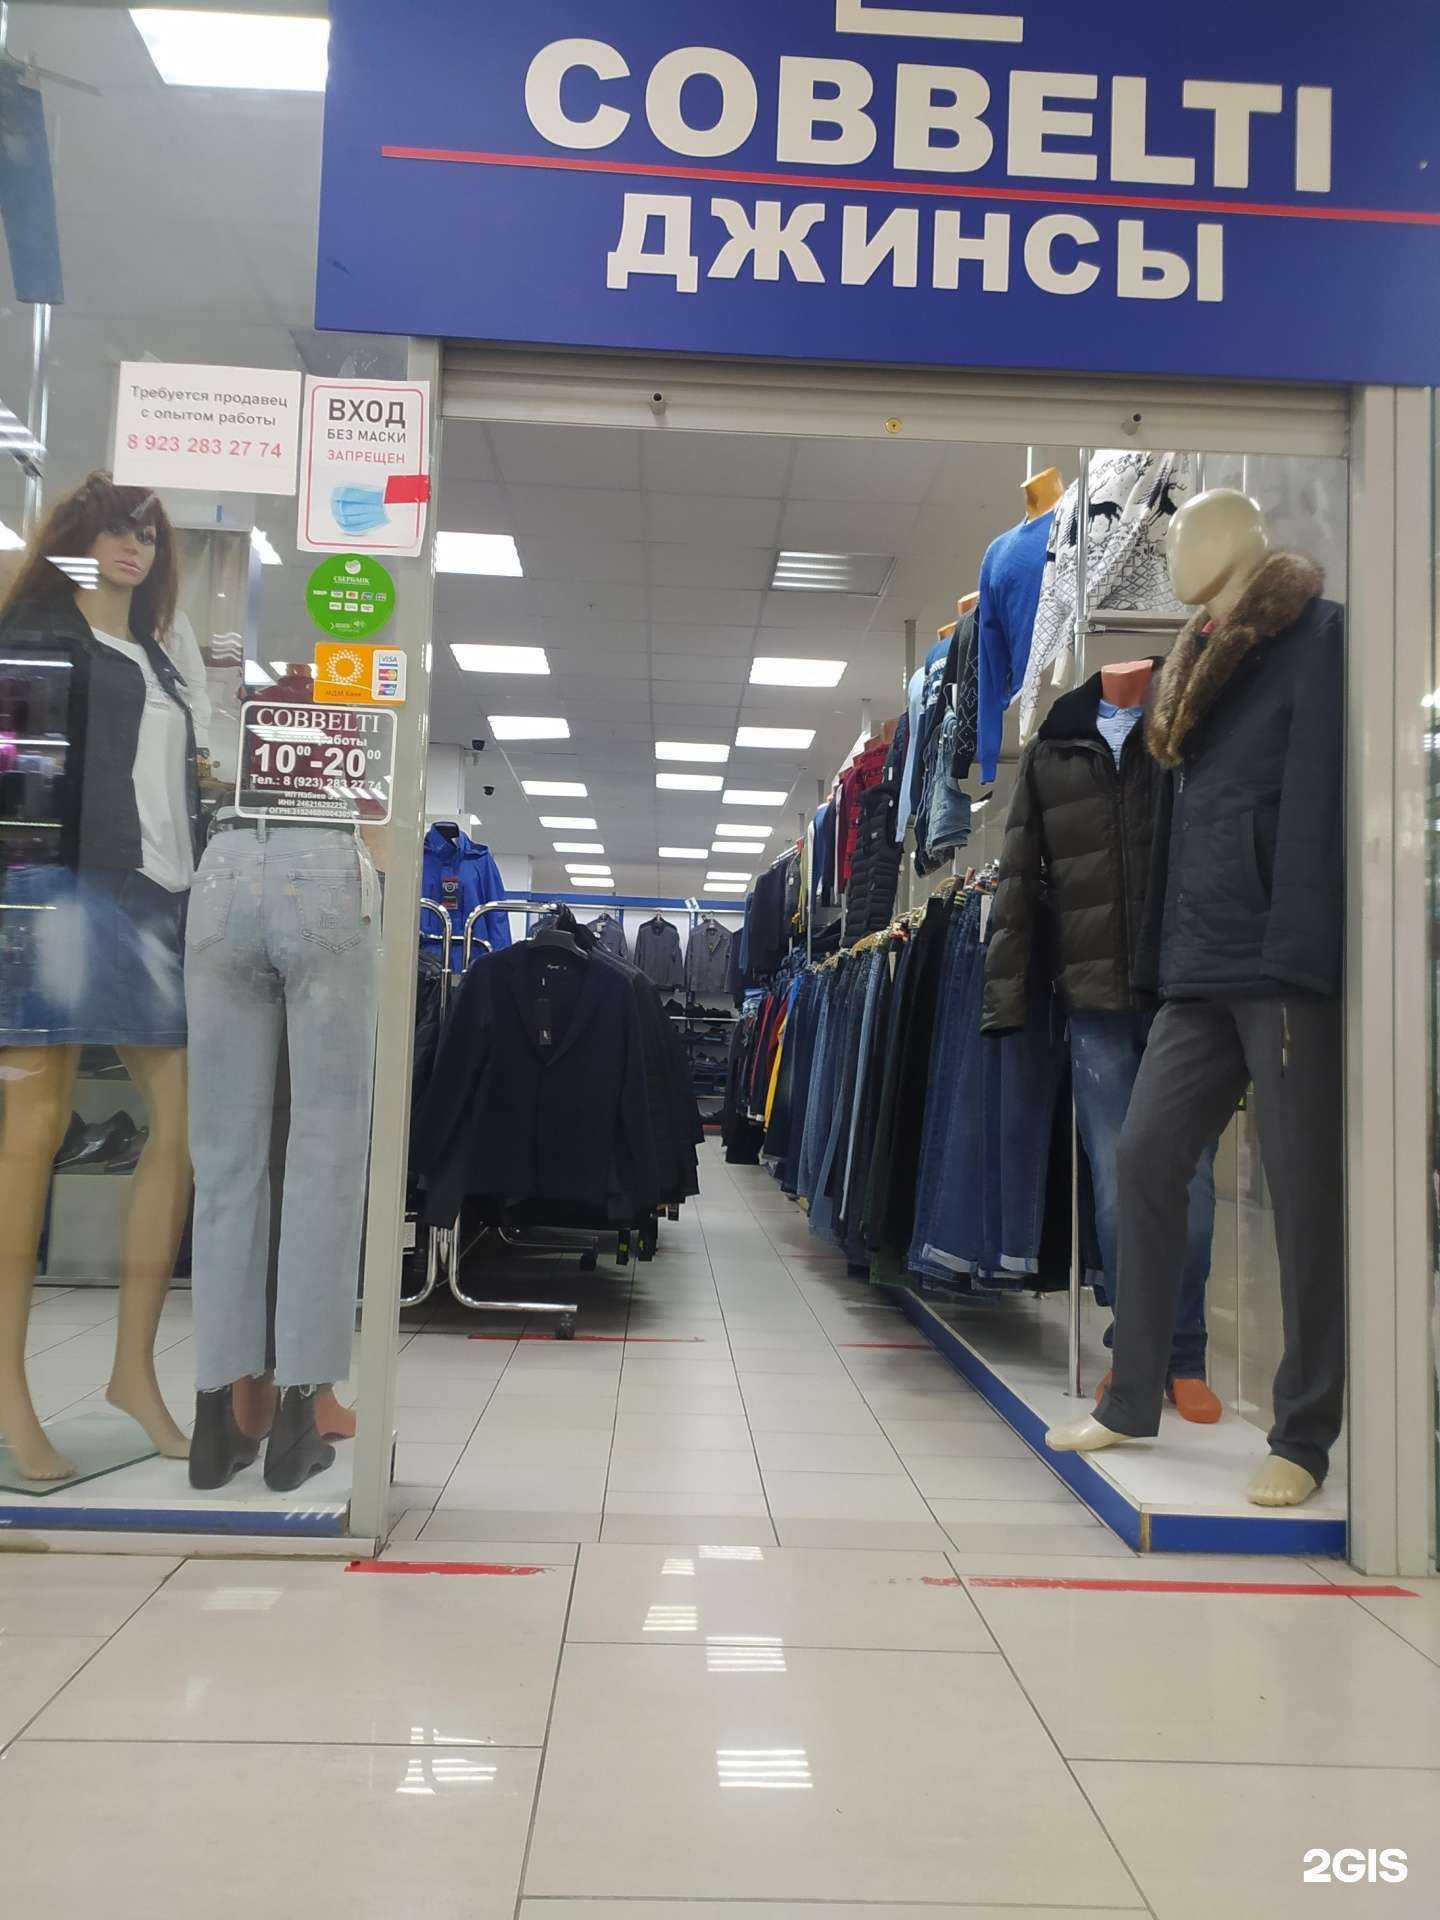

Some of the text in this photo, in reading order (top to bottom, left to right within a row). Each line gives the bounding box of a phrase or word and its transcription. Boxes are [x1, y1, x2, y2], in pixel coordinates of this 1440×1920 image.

[523, 37, 1332, 194] COBBELTI
[605, 192, 1223, 303] ДЖИНСЫ
[131, 384, 288, 408] Требуется продавец
[141, 409, 276, 426] с опытом работы
[328, 398, 406, 429] ВХОД
[128, 434, 282, 459] 8 923 283 27 74
[327, 428, 406, 443] БЕЗ МАСКИ
[327, 450, 405, 465] ЗАПРЕЩЕН
[256, 708, 380, 733] COBBELTI
[283, 776, 291, 786] 8
[293, 776, 324, 789] (923)
